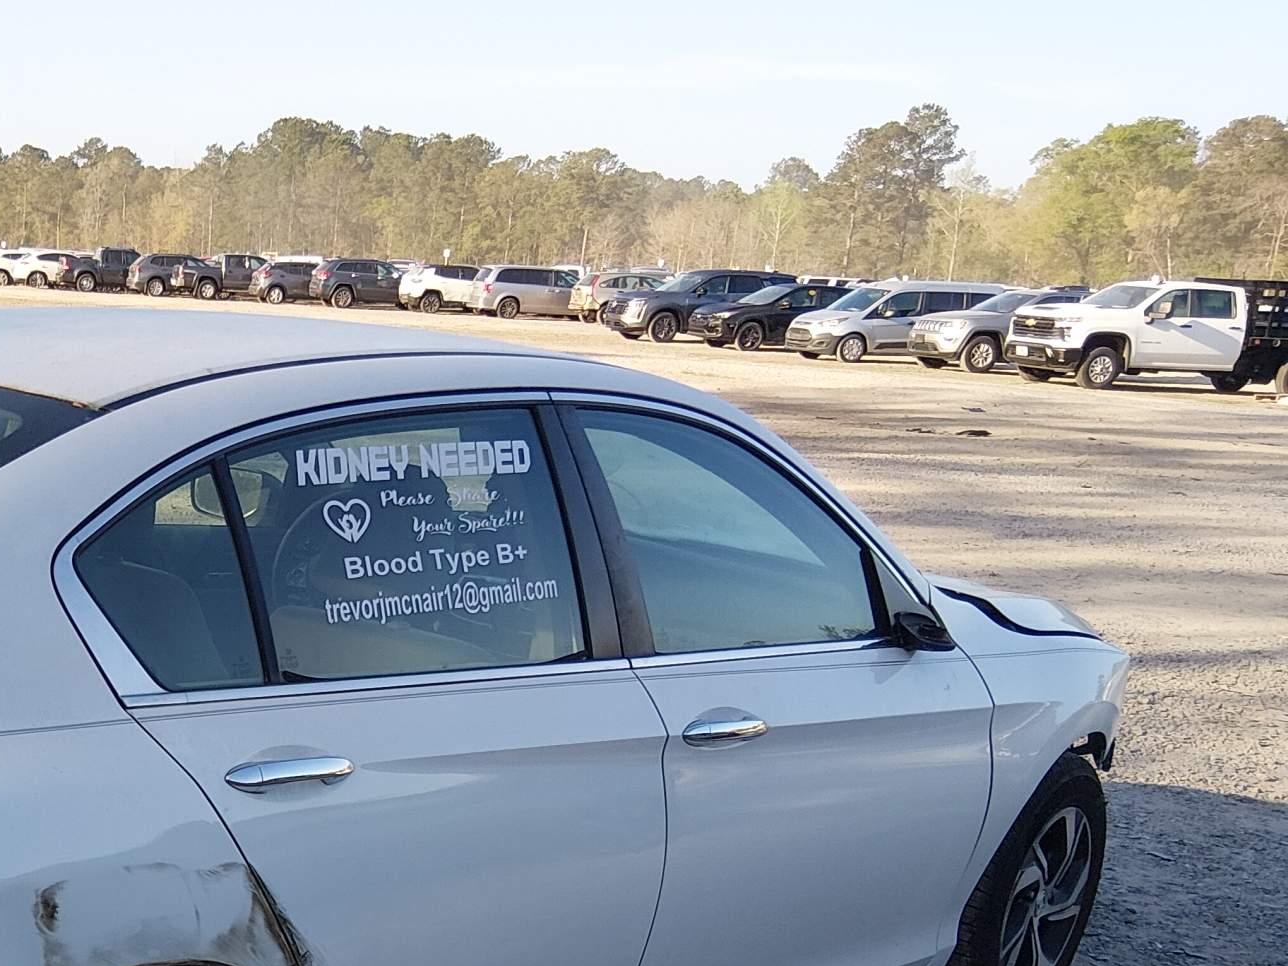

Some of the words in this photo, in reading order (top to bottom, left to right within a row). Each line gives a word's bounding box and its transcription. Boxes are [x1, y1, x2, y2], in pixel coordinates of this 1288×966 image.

[295, 445, 409, 486] KIDNEY
[419, 440, 531, 478] NEEDED
[379, 489, 434, 507] Please
[412, 516, 455, 541] Your
[458, 507, 525, 533] Spare!!!
[344, 552, 423, 579] Blood
[428, 548, 490, 574] Type
[496, 543, 528, 564] B+
[325, 578, 558, 624] trevorjmcnair12@gmail.com
